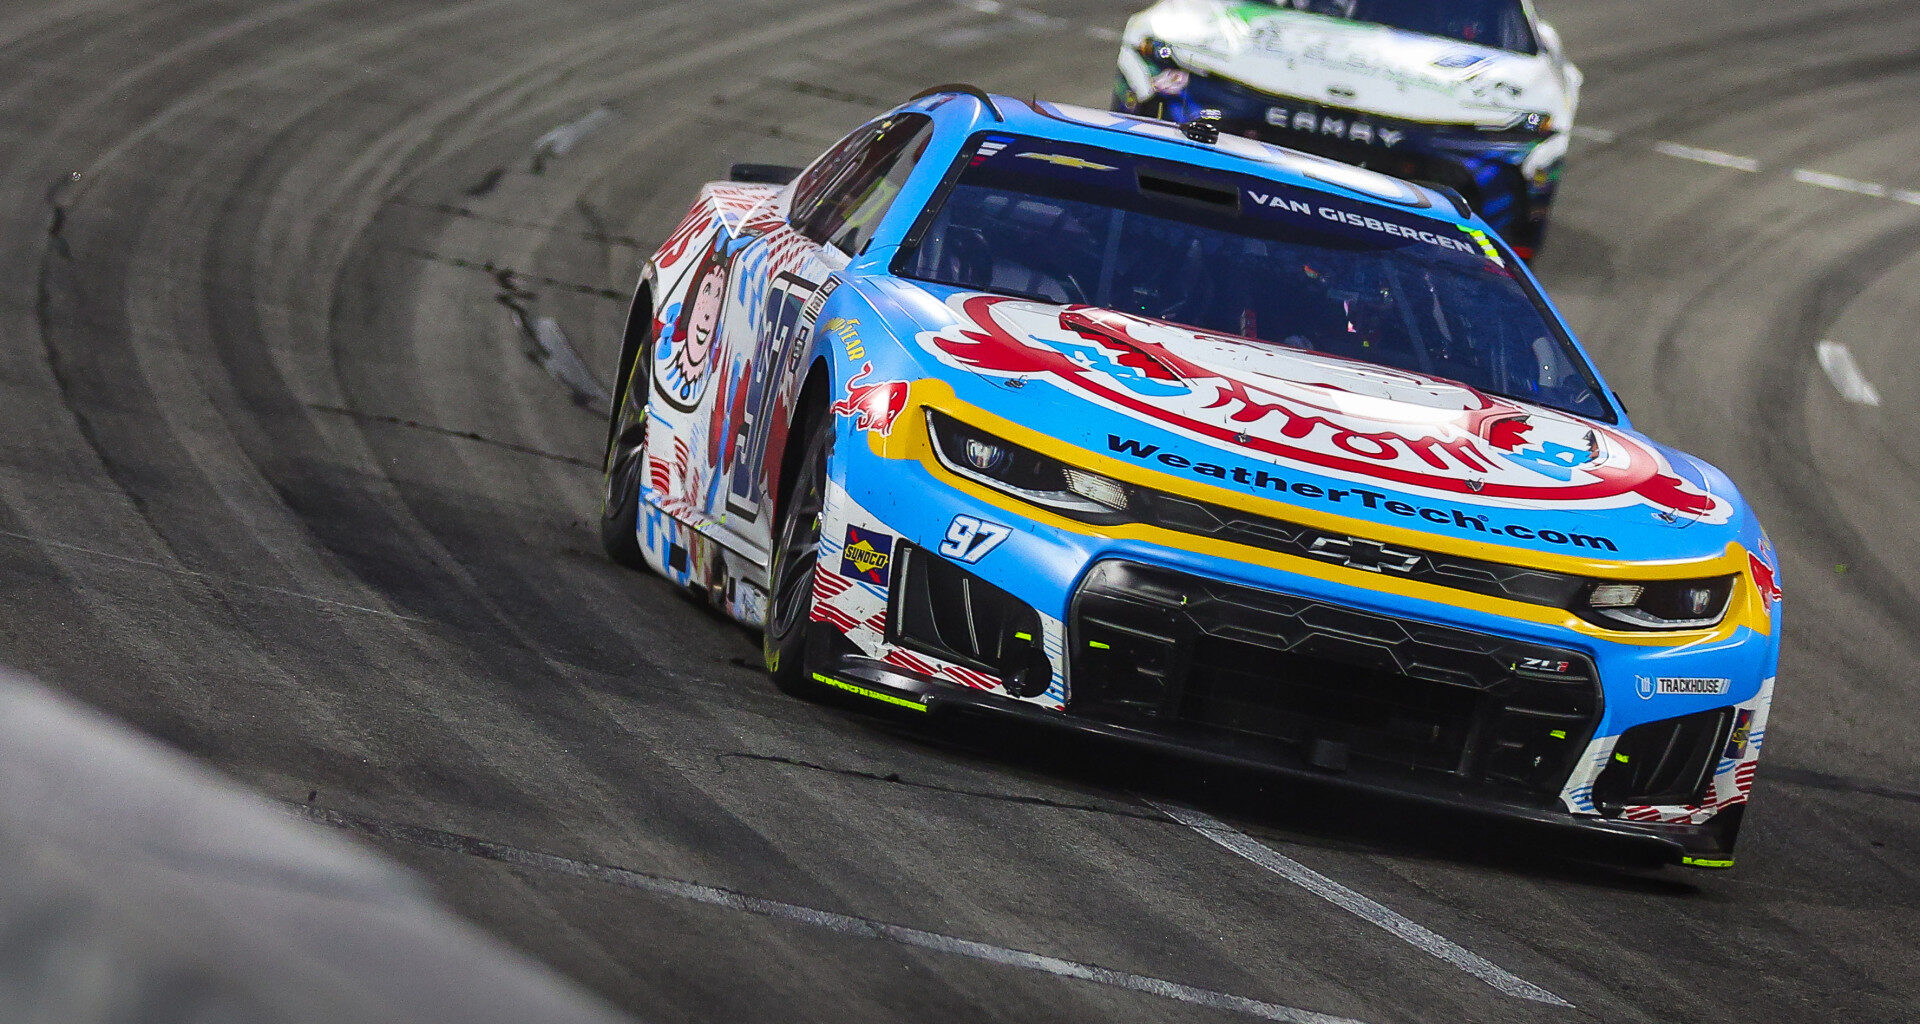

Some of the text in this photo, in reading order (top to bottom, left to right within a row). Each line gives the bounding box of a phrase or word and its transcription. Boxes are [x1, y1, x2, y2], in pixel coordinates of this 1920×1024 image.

[1247, 190, 1475, 255] VAN GISBERGEN
[939, 513, 1013, 565] 97
[844, 546, 888, 568] SUNOCO
[1519, 657, 1569, 673] ZL1
[1659, 678, 1720, 694] TRACKHOUSE
